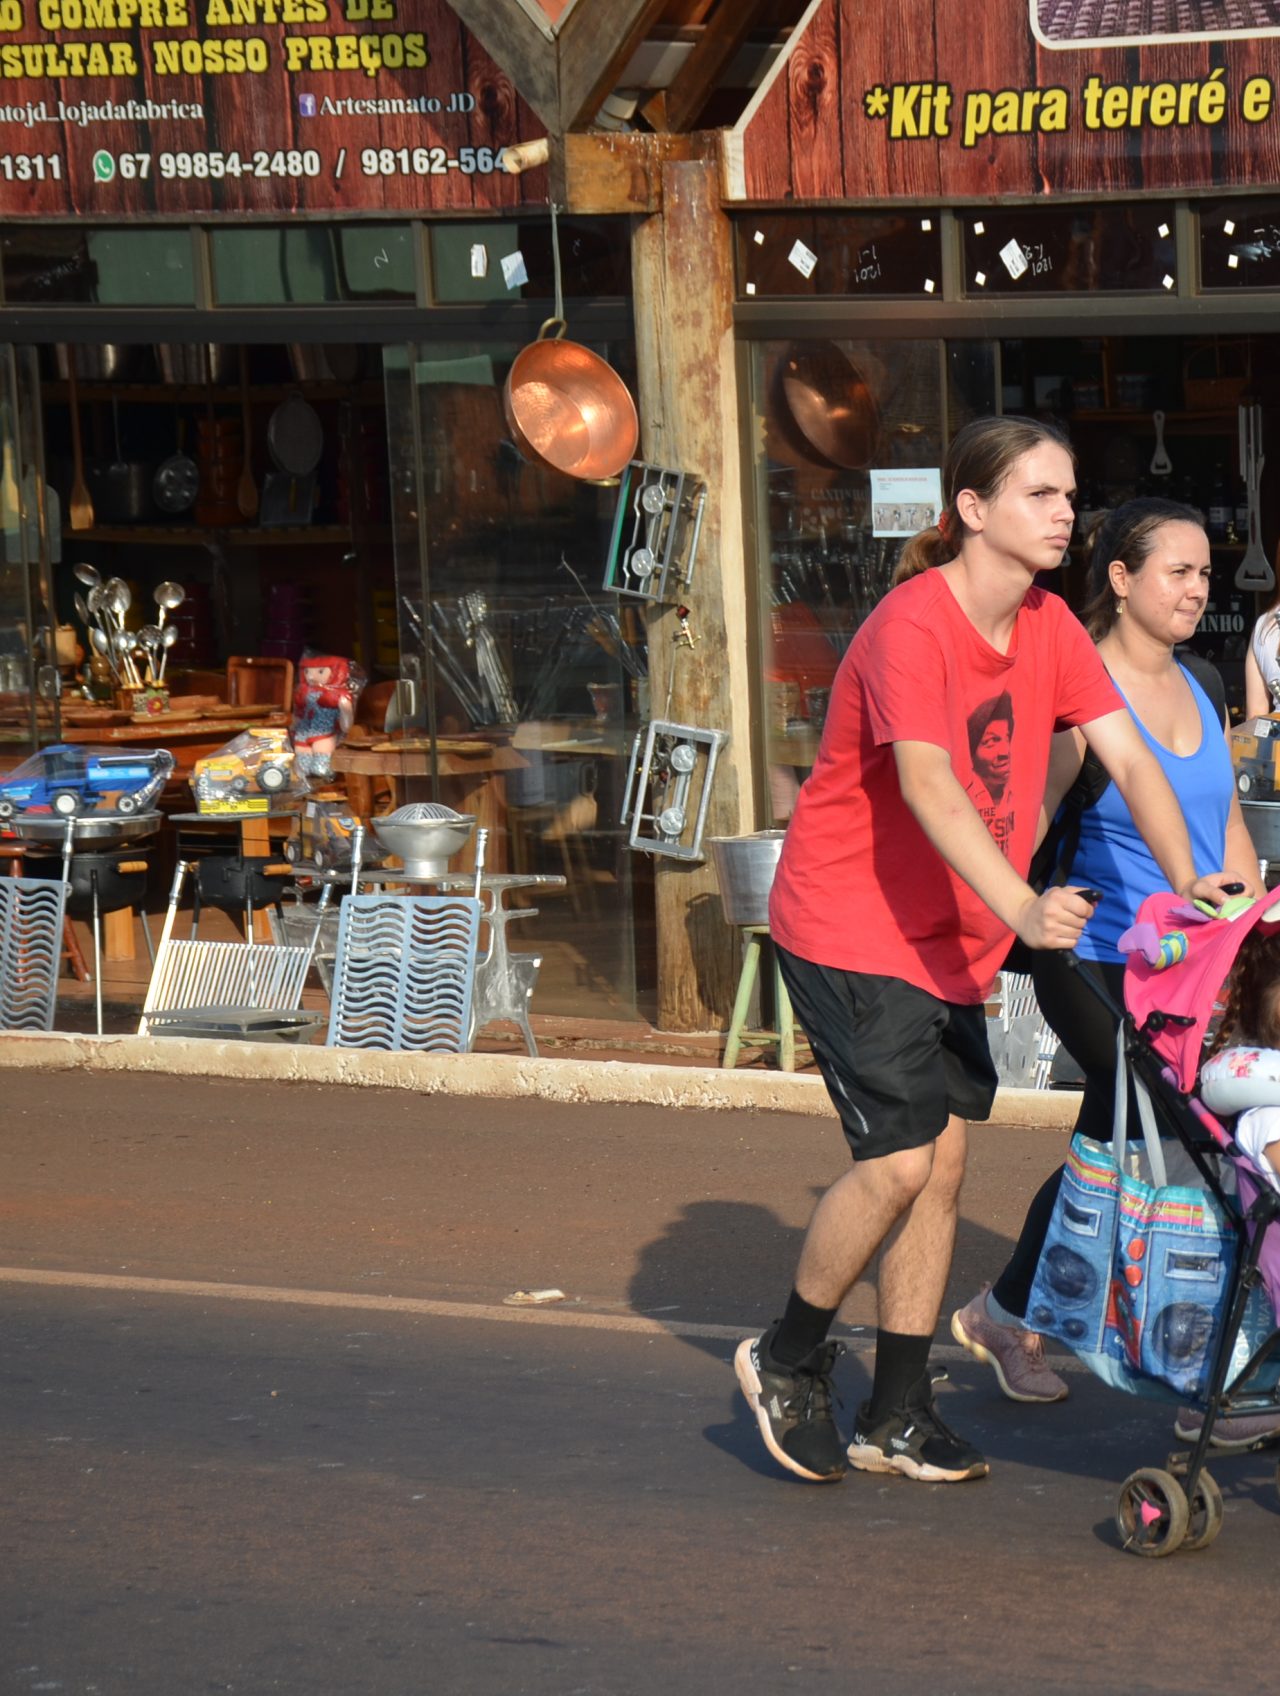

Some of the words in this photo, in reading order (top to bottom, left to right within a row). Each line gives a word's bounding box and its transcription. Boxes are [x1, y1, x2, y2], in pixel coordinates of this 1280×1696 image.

[0, 0, 23, 31] O
[39, 0, 189, 30] COMPRE
[206, 0, 327, 26] ANTES
[0, 42, 137, 78] SULTAR
[153, 38, 268, 75] NOSSO
[285, 33, 428, 77] PREÇOS
[320, 95, 441, 116] Artesanato
[446, 92, 475, 113] JD
[964, 89, 1067, 146] para
[1084, 68, 1226, 130] tereré
[1243, 78, 1271, 121] e
[0, 154, 61, 180] 1311
[119, 153, 150, 179] 67
[160, 151, 320, 178] 99854-2480
[335, 149, 346, 178] /
[361, 147, 508, 175] 98162-564
